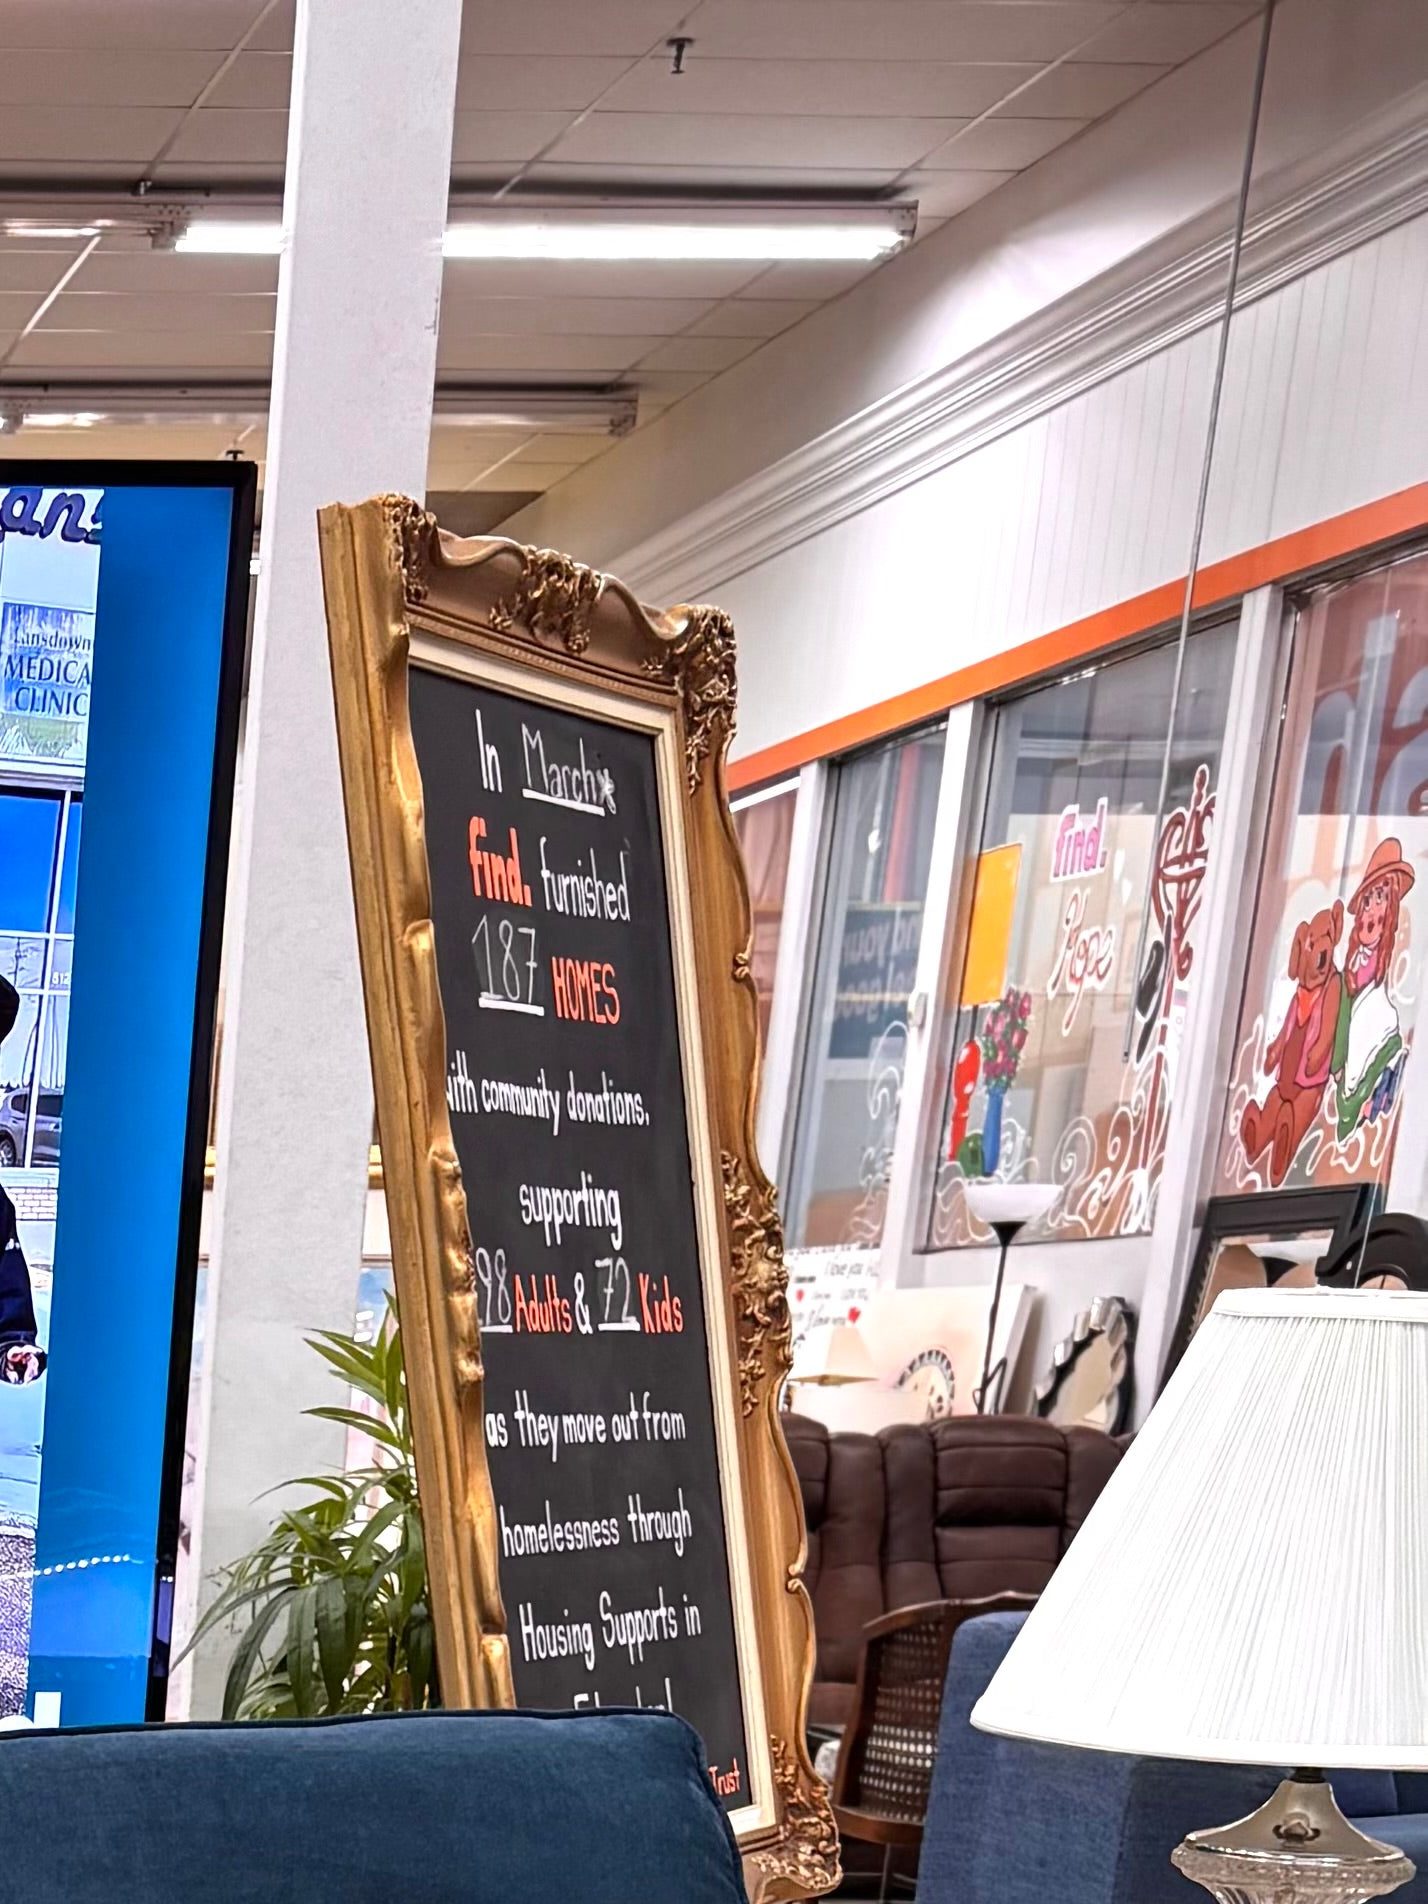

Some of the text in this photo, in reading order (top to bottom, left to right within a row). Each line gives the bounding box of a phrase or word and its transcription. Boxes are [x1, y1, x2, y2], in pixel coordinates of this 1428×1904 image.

[15, 687, 89, 717] CLINIC
[475, 709, 502, 793] In
[469, 816, 631, 921] find. furnished
[471, 914, 620, 1024] 187 HOMES
[481, 1068, 560, 1136] community
[567, 1070, 650, 1125] donations.
[519, 1171, 622, 1251] supporting
[475, 1247, 683, 1335] 98 Adults & 72 Kids
[485, 1390, 685, 1462] as they move out from
[499, 1487, 692, 1557] homelessness through
[519, 1586, 701, 1671] Housing Supports in
